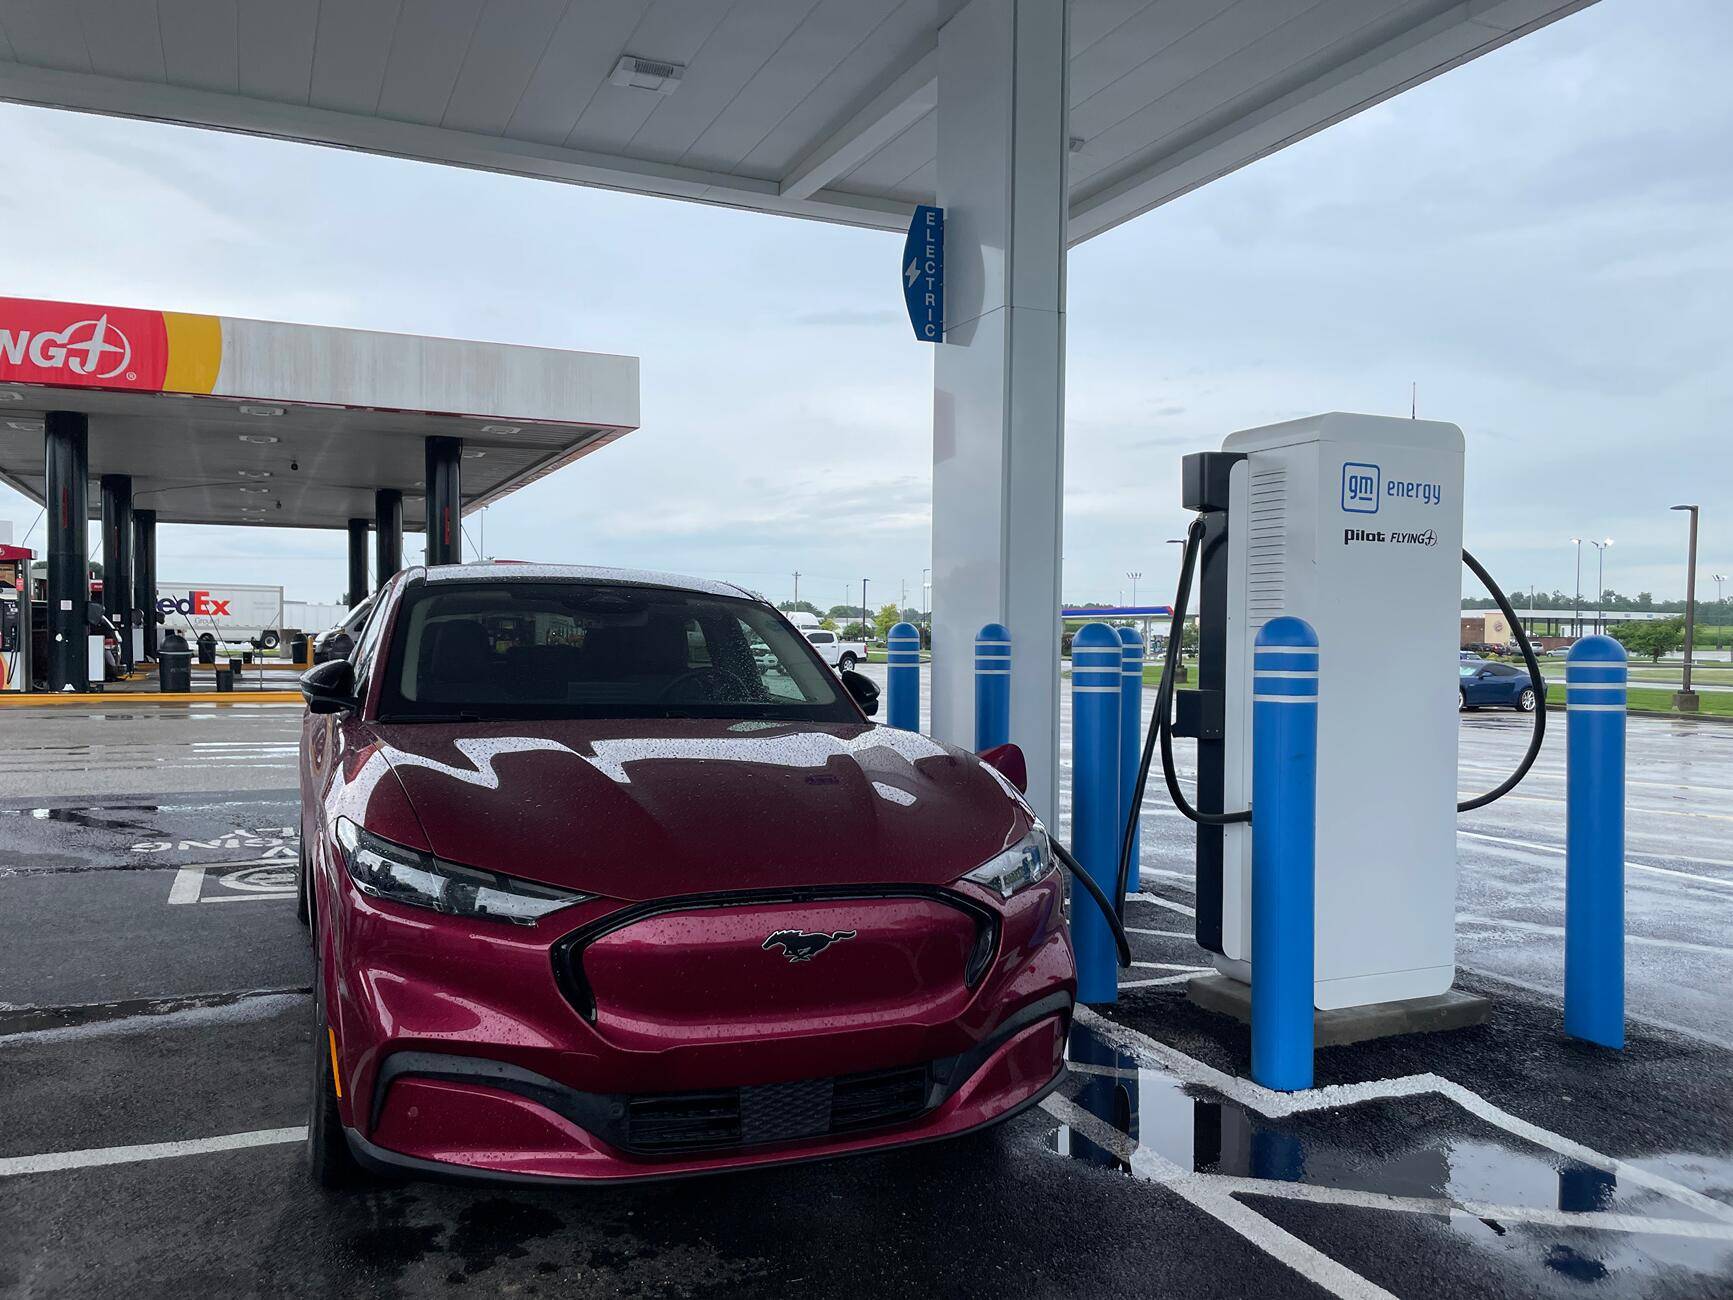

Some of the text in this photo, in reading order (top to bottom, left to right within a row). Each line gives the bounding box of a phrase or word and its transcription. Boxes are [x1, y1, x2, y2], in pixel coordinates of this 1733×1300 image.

[925, 211, 936, 337] ELECTRIC
[0, 329, 69, 368] NG
[1349, 475, 1441, 505] gm energy
[156, 591, 231, 616] edEx
[130, 837, 299, 852] GING
